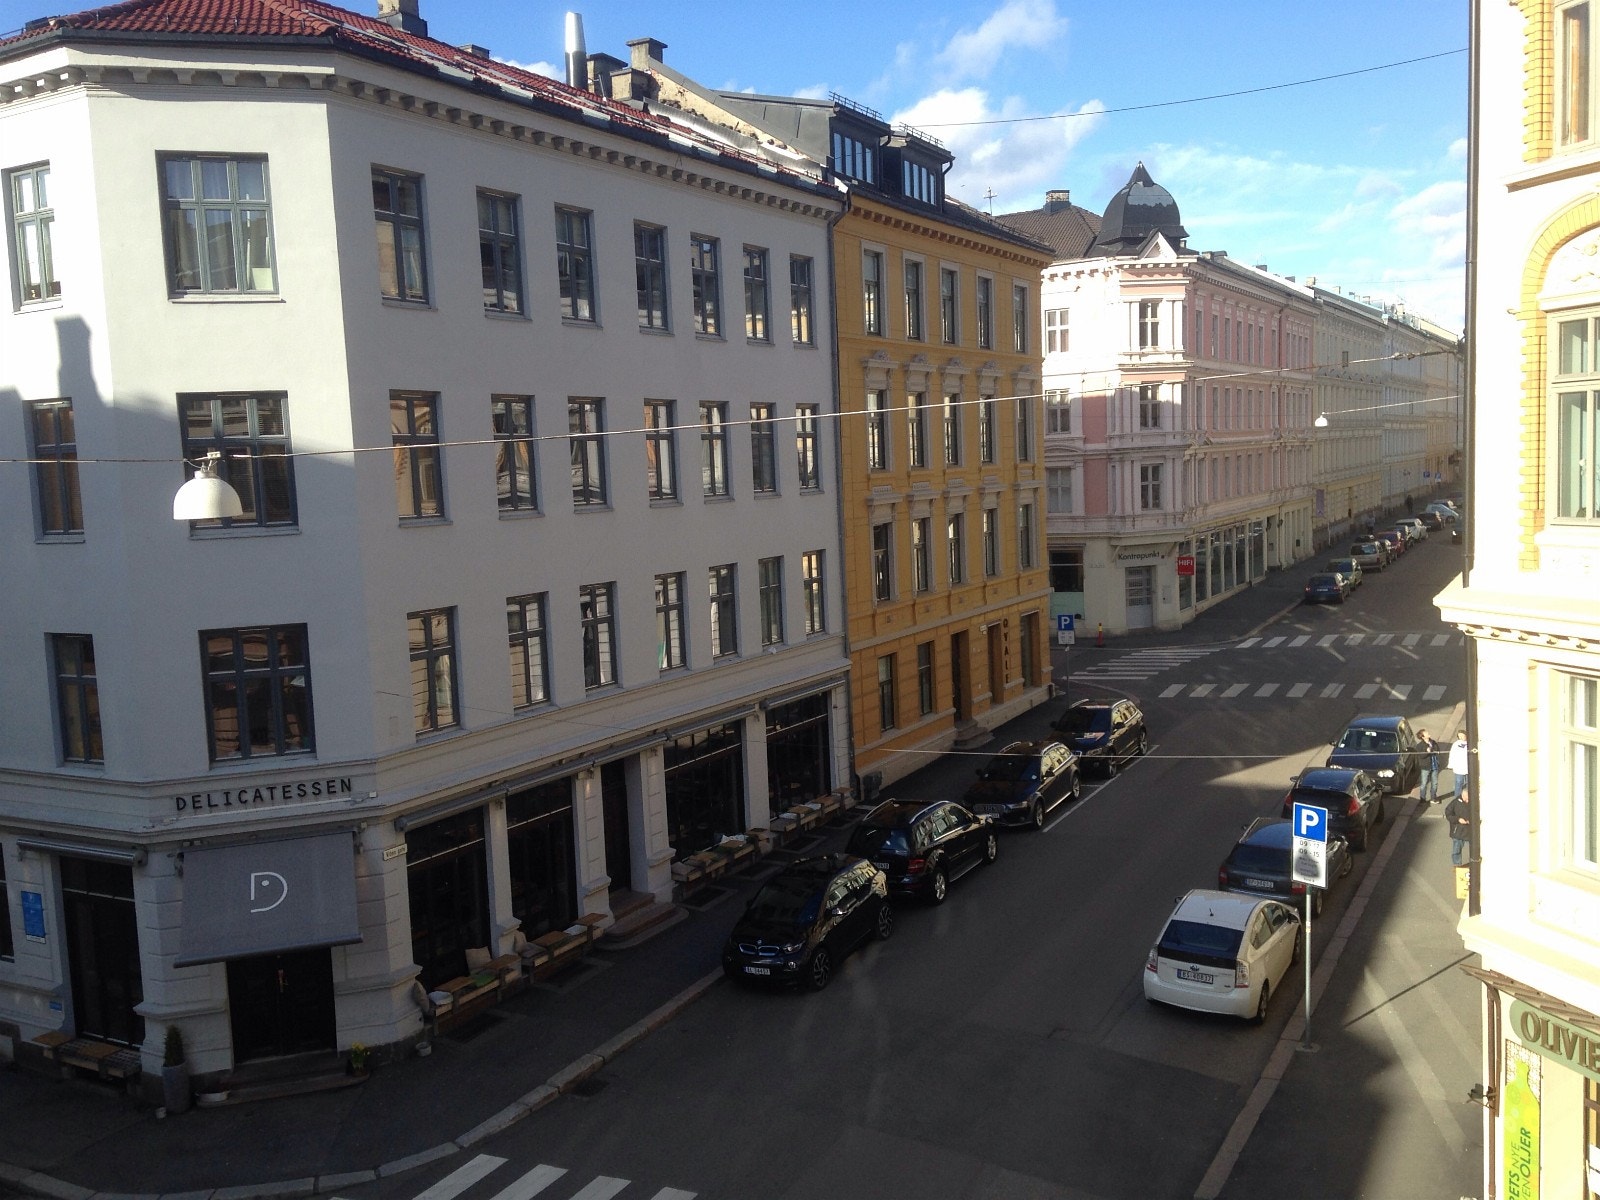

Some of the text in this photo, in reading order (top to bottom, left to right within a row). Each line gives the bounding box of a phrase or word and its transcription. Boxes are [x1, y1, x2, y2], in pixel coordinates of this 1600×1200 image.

[1061, 616, 1070, 629] P
[175, 778, 352, 811] DELICATESSEN
[1301, 808, 1320, 835] P
[1510, 1141, 1520, 1170] NYE
